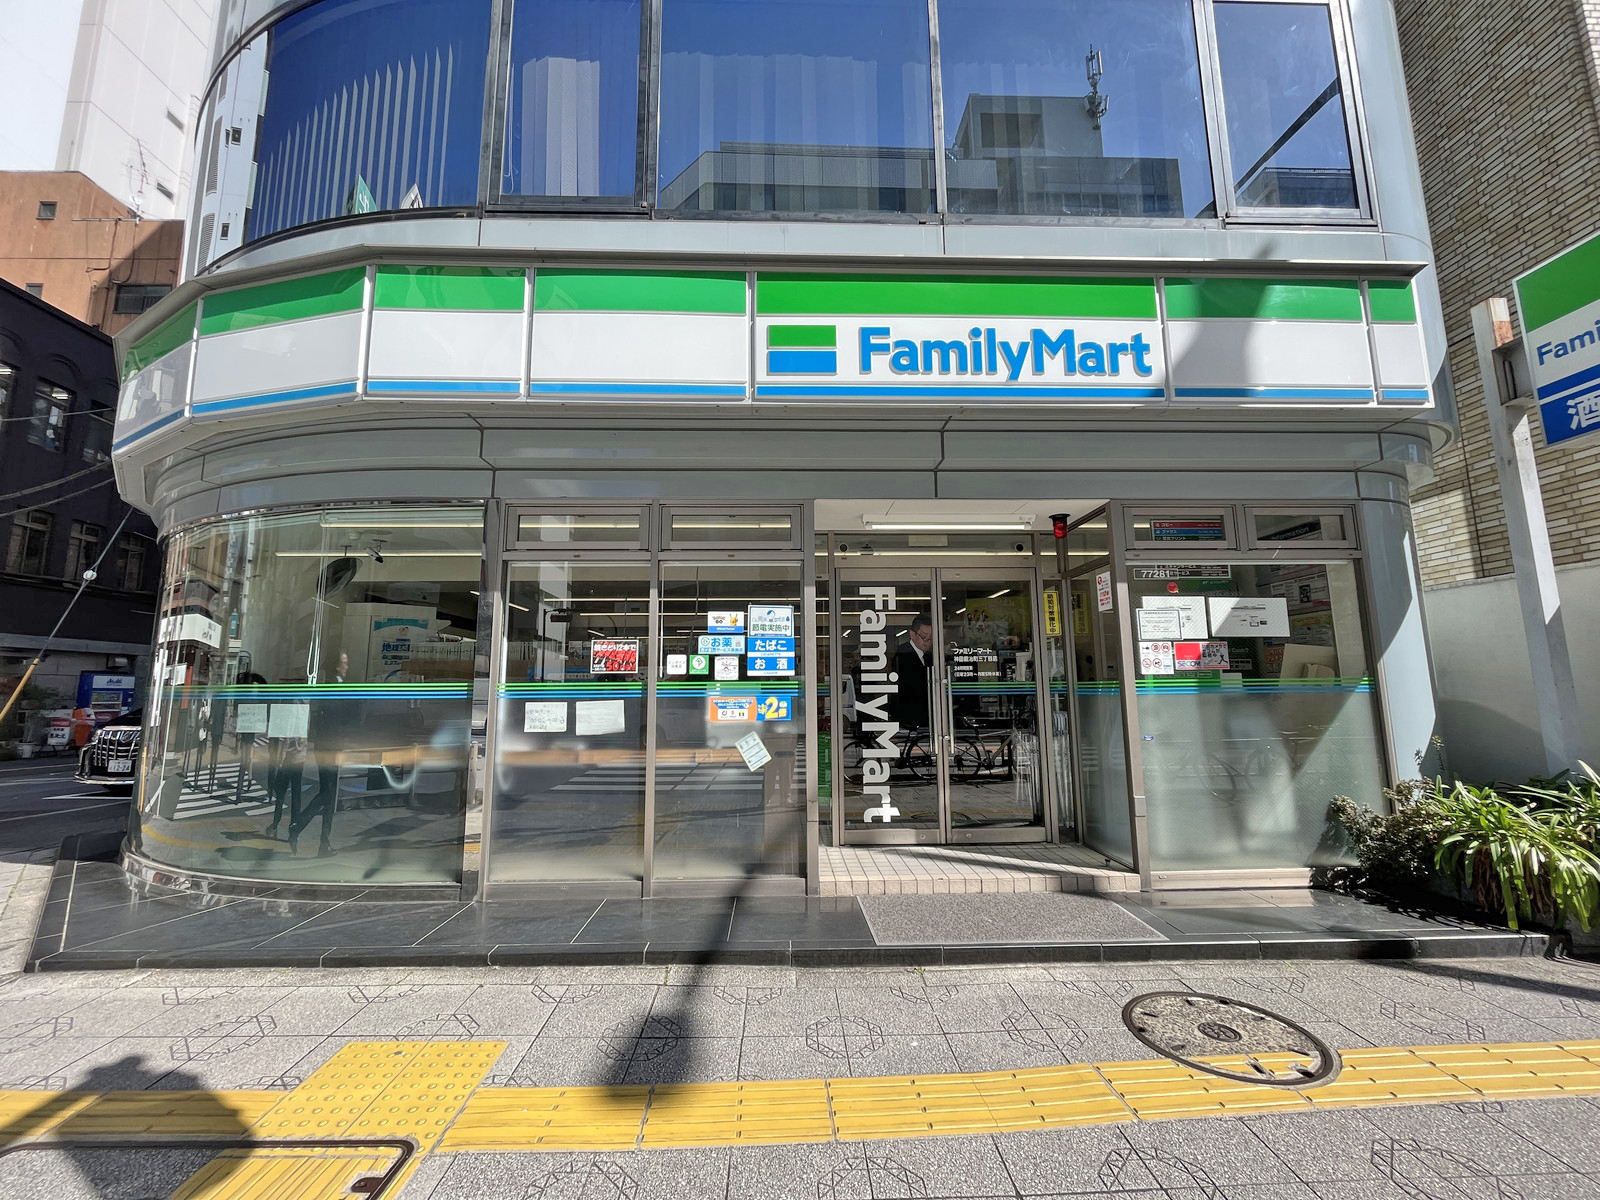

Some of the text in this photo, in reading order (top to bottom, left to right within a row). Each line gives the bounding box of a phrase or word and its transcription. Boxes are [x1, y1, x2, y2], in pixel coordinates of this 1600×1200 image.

[859, 327, 1152, 382] FamilyMart
[1141, 570, 1170, 578] 77281
[711, 637, 732, 647] お薬
[755, 640, 787, 650] たばこ
[855, 587, 900, 823] FamilyMart
